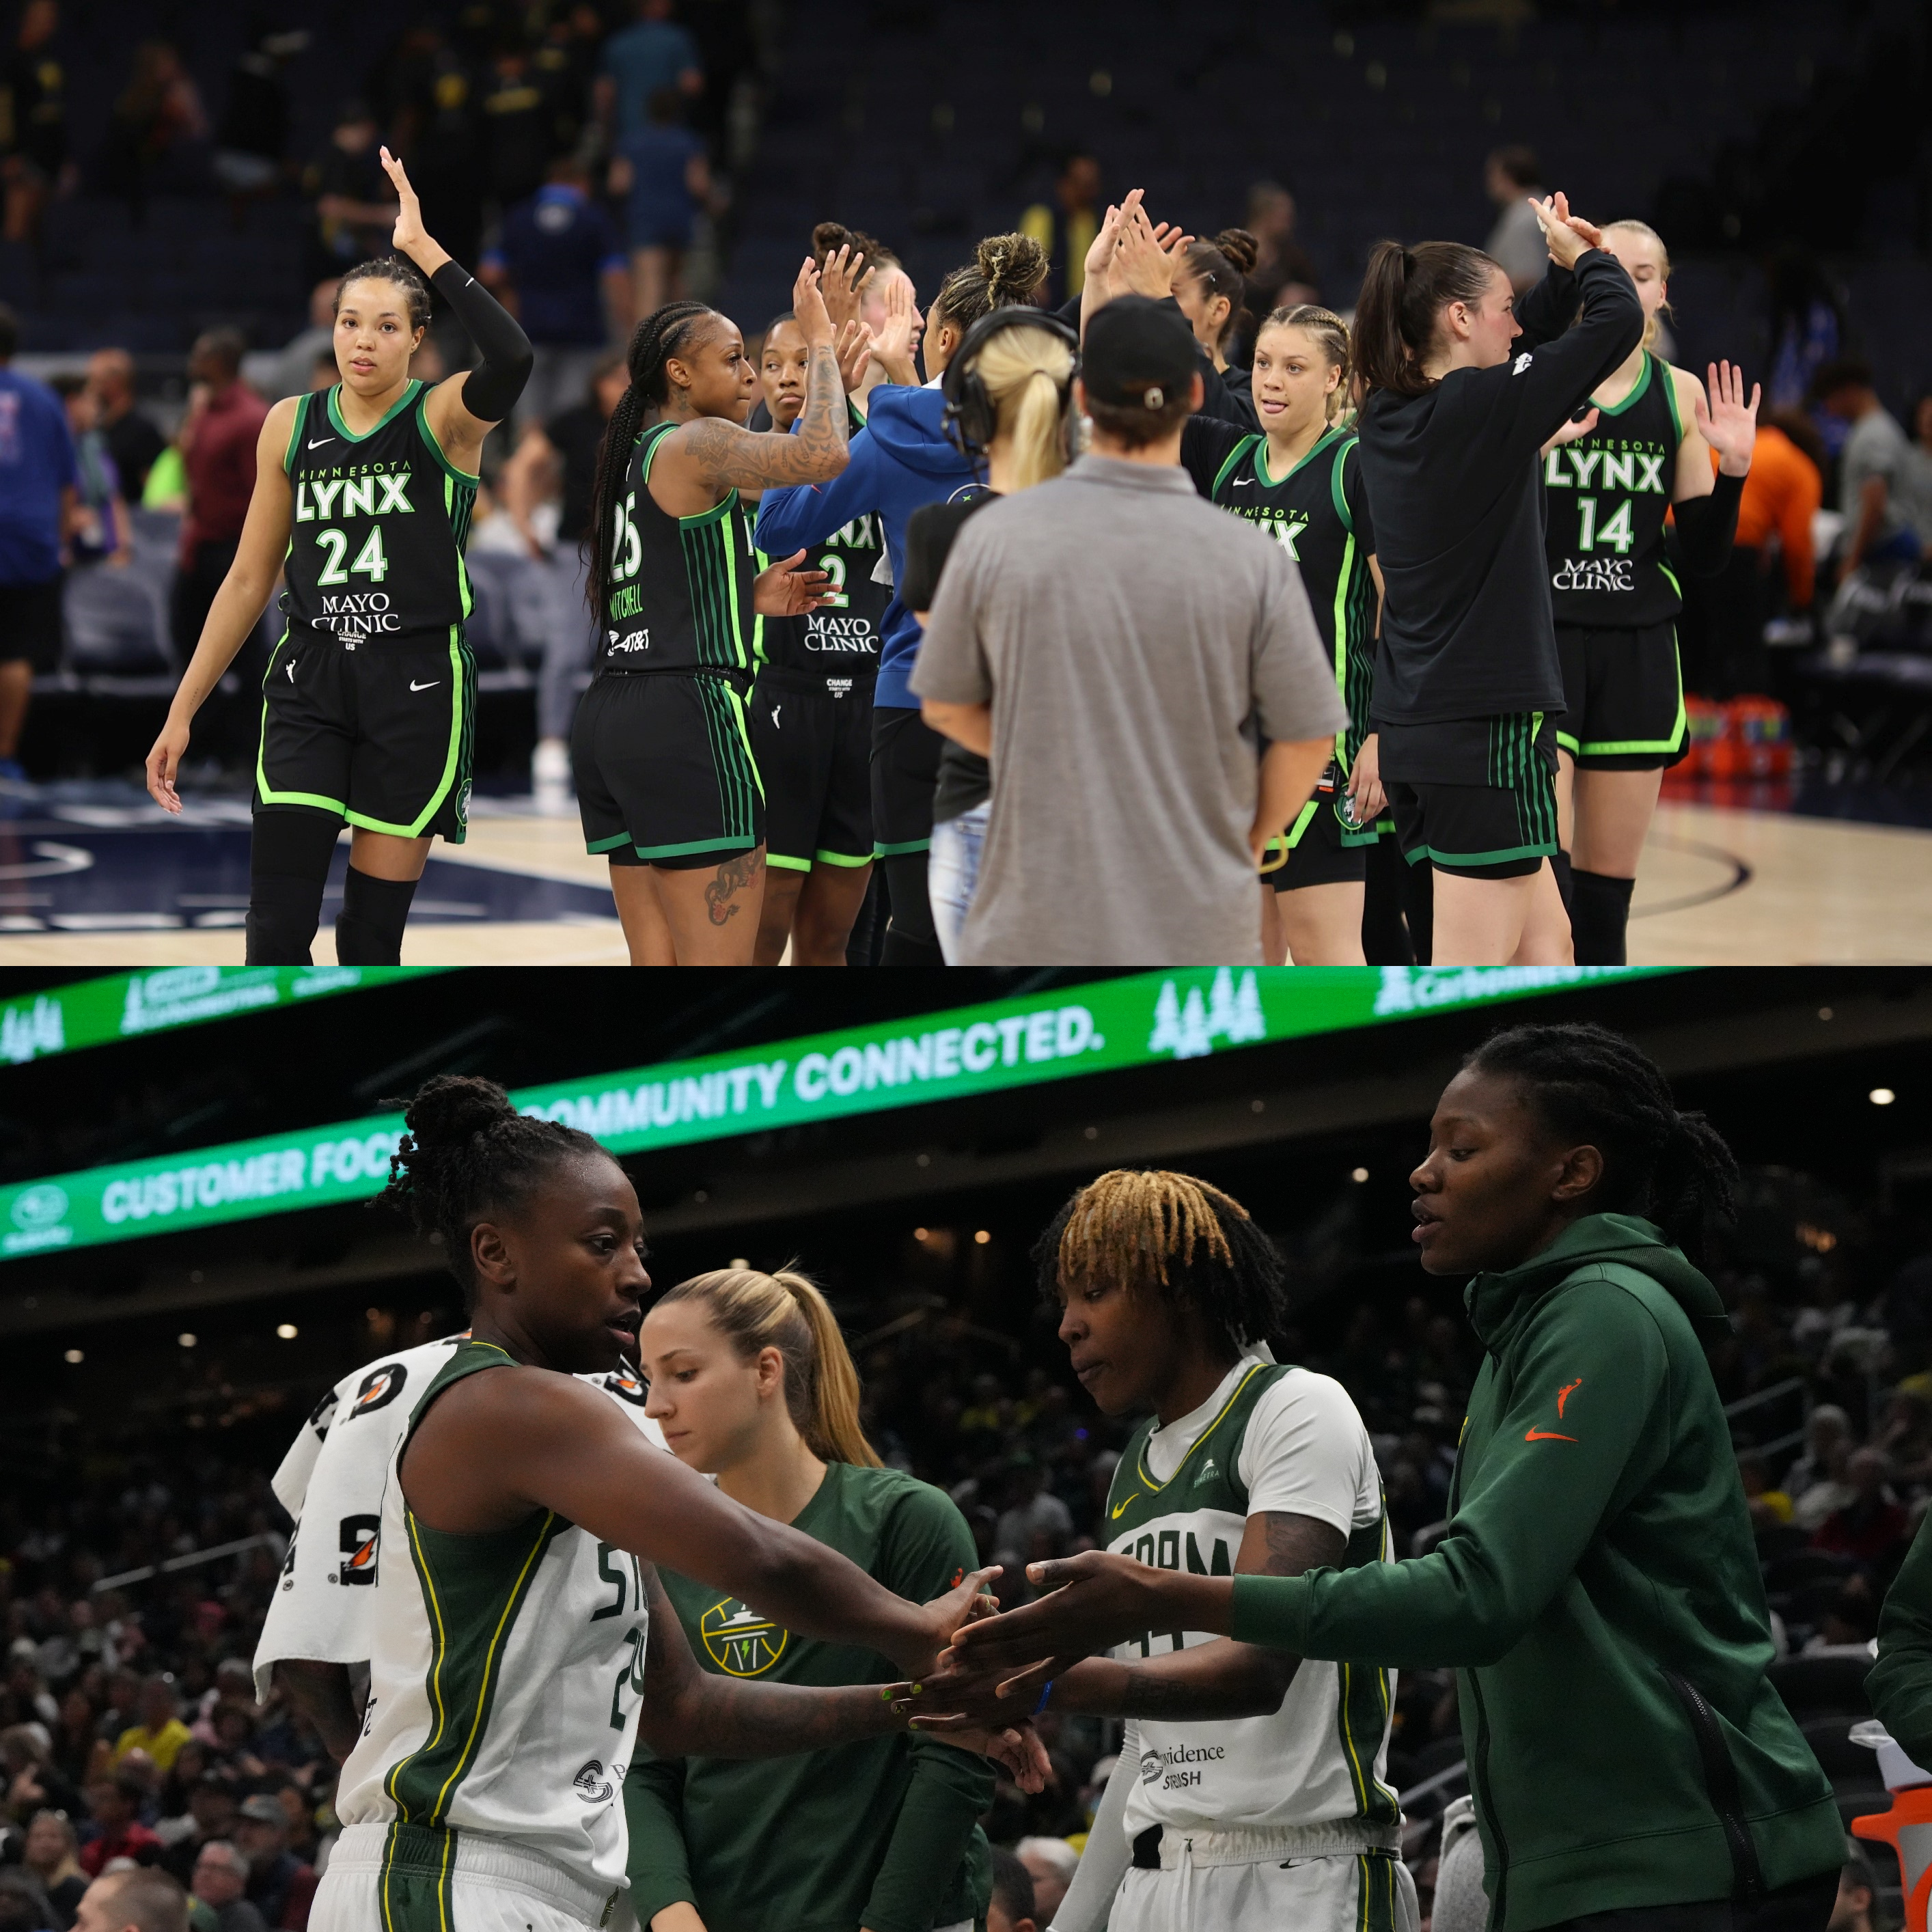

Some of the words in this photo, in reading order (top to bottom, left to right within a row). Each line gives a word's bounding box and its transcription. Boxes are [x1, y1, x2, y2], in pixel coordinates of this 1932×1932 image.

[1563, 438, 1665, 454] INNESOTA
[299, 460, 411, 480] MINNESOTA
[1545, 447, 1665, 495] LYNX
[296, 473, 415, 523] LYNX
[1577, 496, 1634, 553] 14
[316, 525, 387, 586] 24
[819, 554, 849, 607] 2
[321, 593, 390, 615] MAYO
[806, 614, 870, 636] MAYO
[345, 642, 355, 651] US
[613, 629, 649, 652] AT&T
[804, 633, 879, 653] CLINIC
[827, 678, 853, 687] CHANGE
[102, 1149, 306, 1224] CUSTOMER
[310, 1129, 419, 1187] FOC
[519, 1060, 788, 1135] OMMUNITY
[793, 1006, 1104, 1102] CONNECTED.
[1159, 1744, 1225, 1767] vidence
